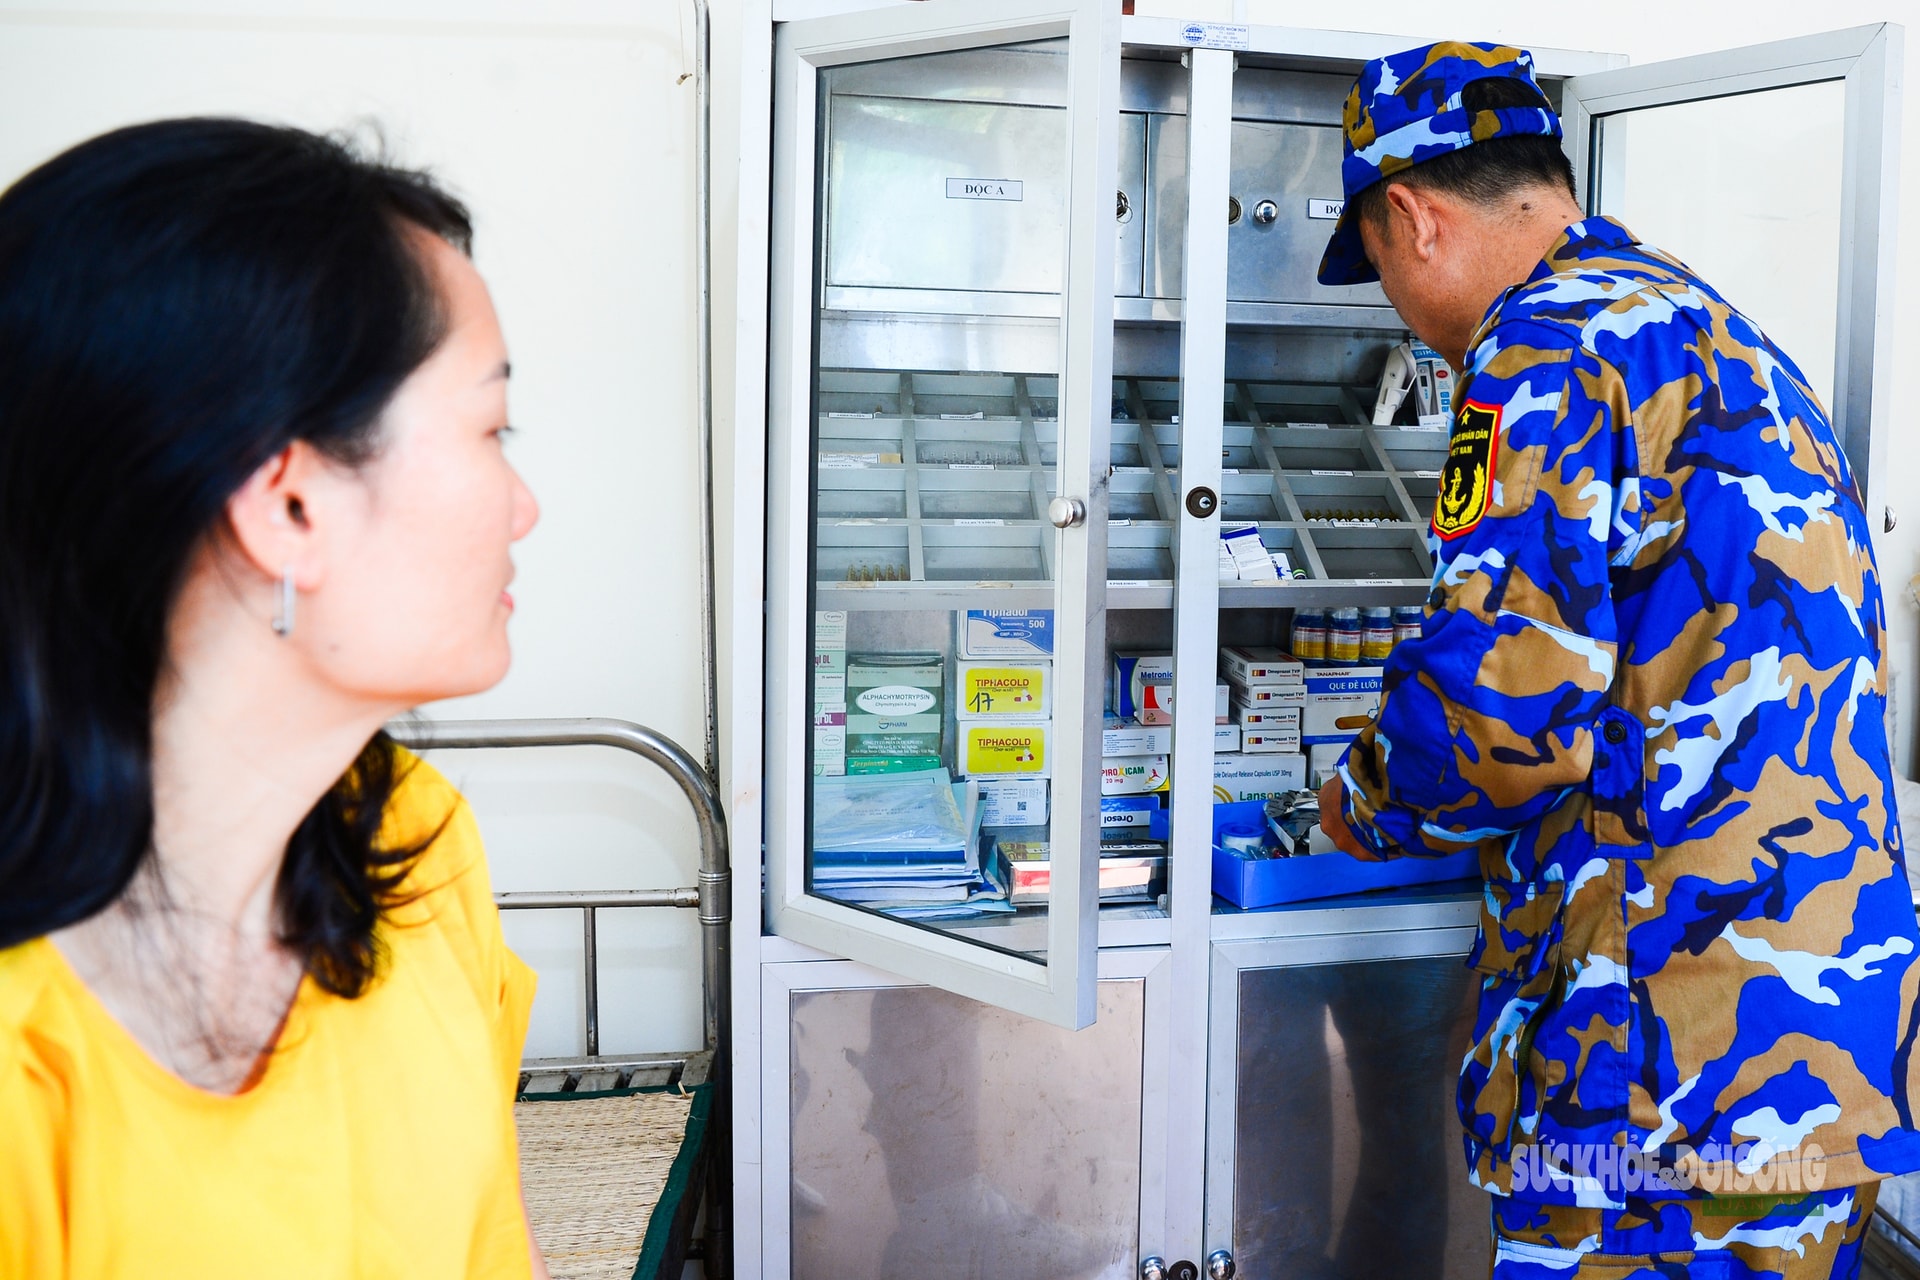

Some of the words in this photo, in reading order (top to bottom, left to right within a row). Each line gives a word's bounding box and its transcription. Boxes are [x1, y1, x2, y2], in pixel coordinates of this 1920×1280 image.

[996, 186, 1005, 195] A
[1028, 620, 1045, 628] 500
[976, 679, 1030, 687] TIPHACOLD
[1329, 682, 1346, 691] QUE
[969, 692, 995, 713] 17
[977, 738, 1031, 746] TIPHACOLD
[1102, 763, 1145, 778] PIROXICAM
[1104, 814, 1133, 824] Oresol
